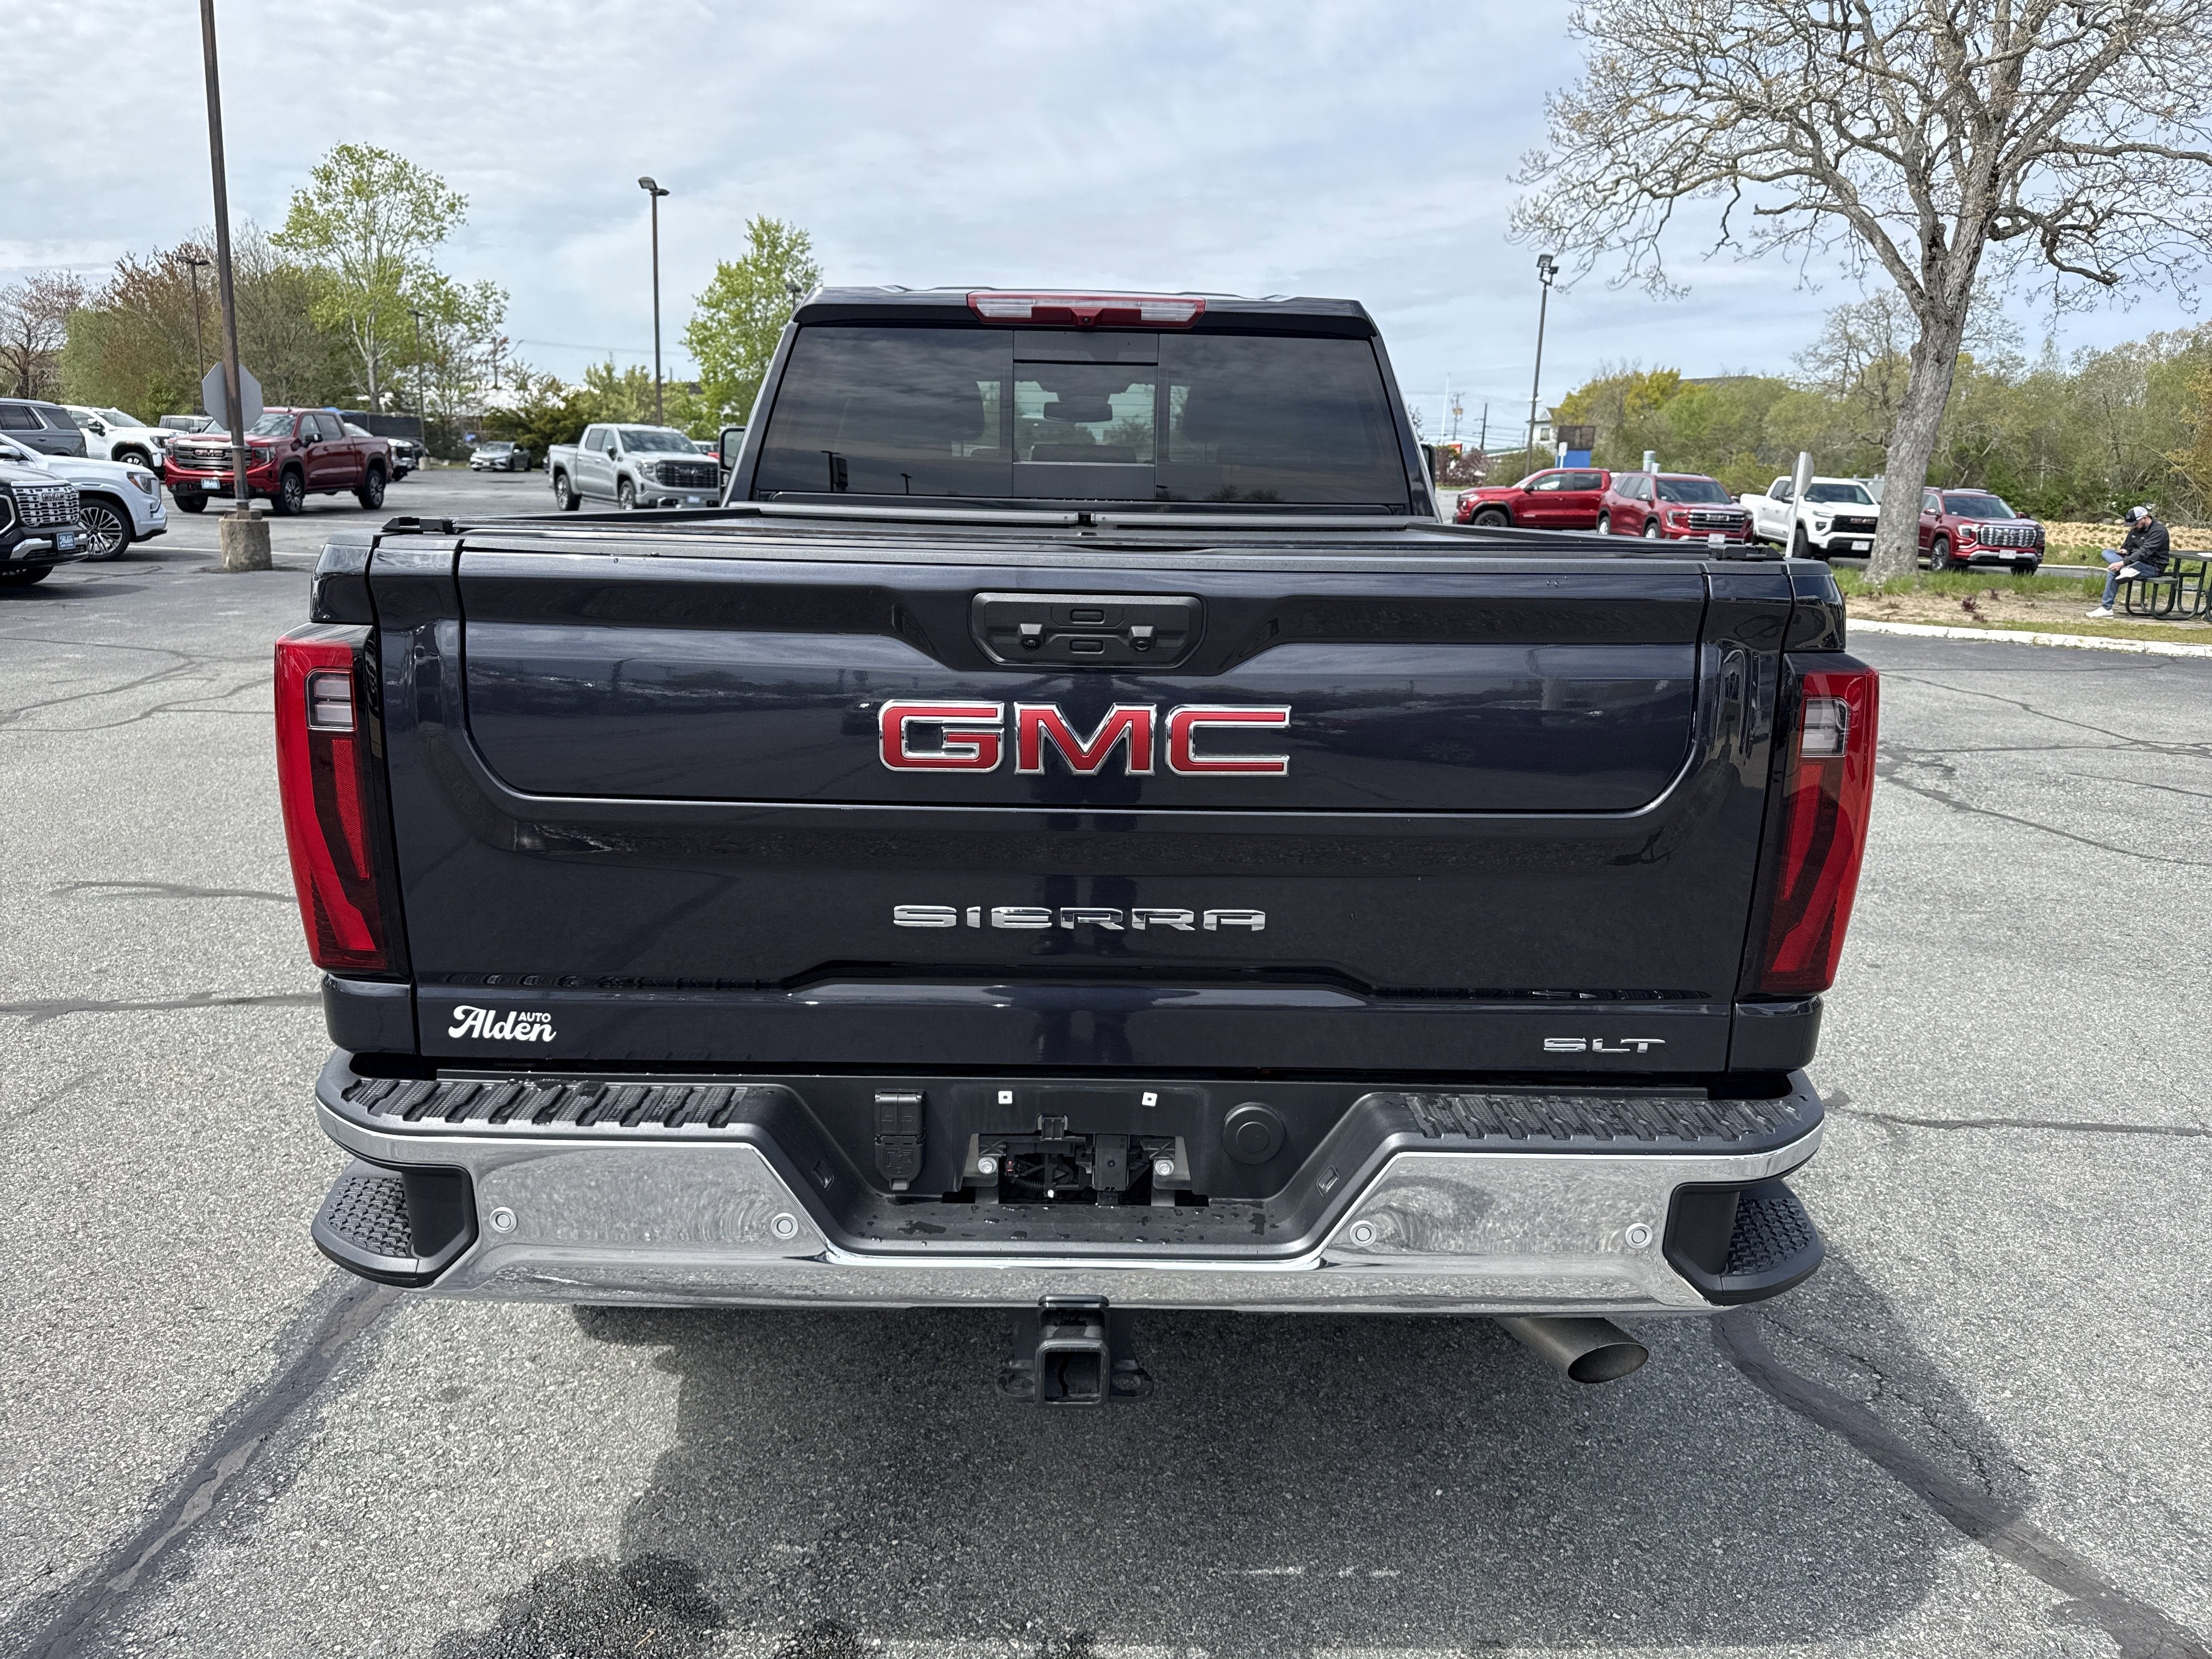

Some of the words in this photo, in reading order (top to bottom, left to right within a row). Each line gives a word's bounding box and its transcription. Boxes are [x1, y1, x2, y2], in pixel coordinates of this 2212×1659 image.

[878, 699, 1292, 777] GMC
[893, 905, 1266, 931] SIERRA
[448, 1005, 557, 1042] Alden
[518, 1012, 551, 1023] AUTO
[1543, 1037, 1666, 1053] SLT
